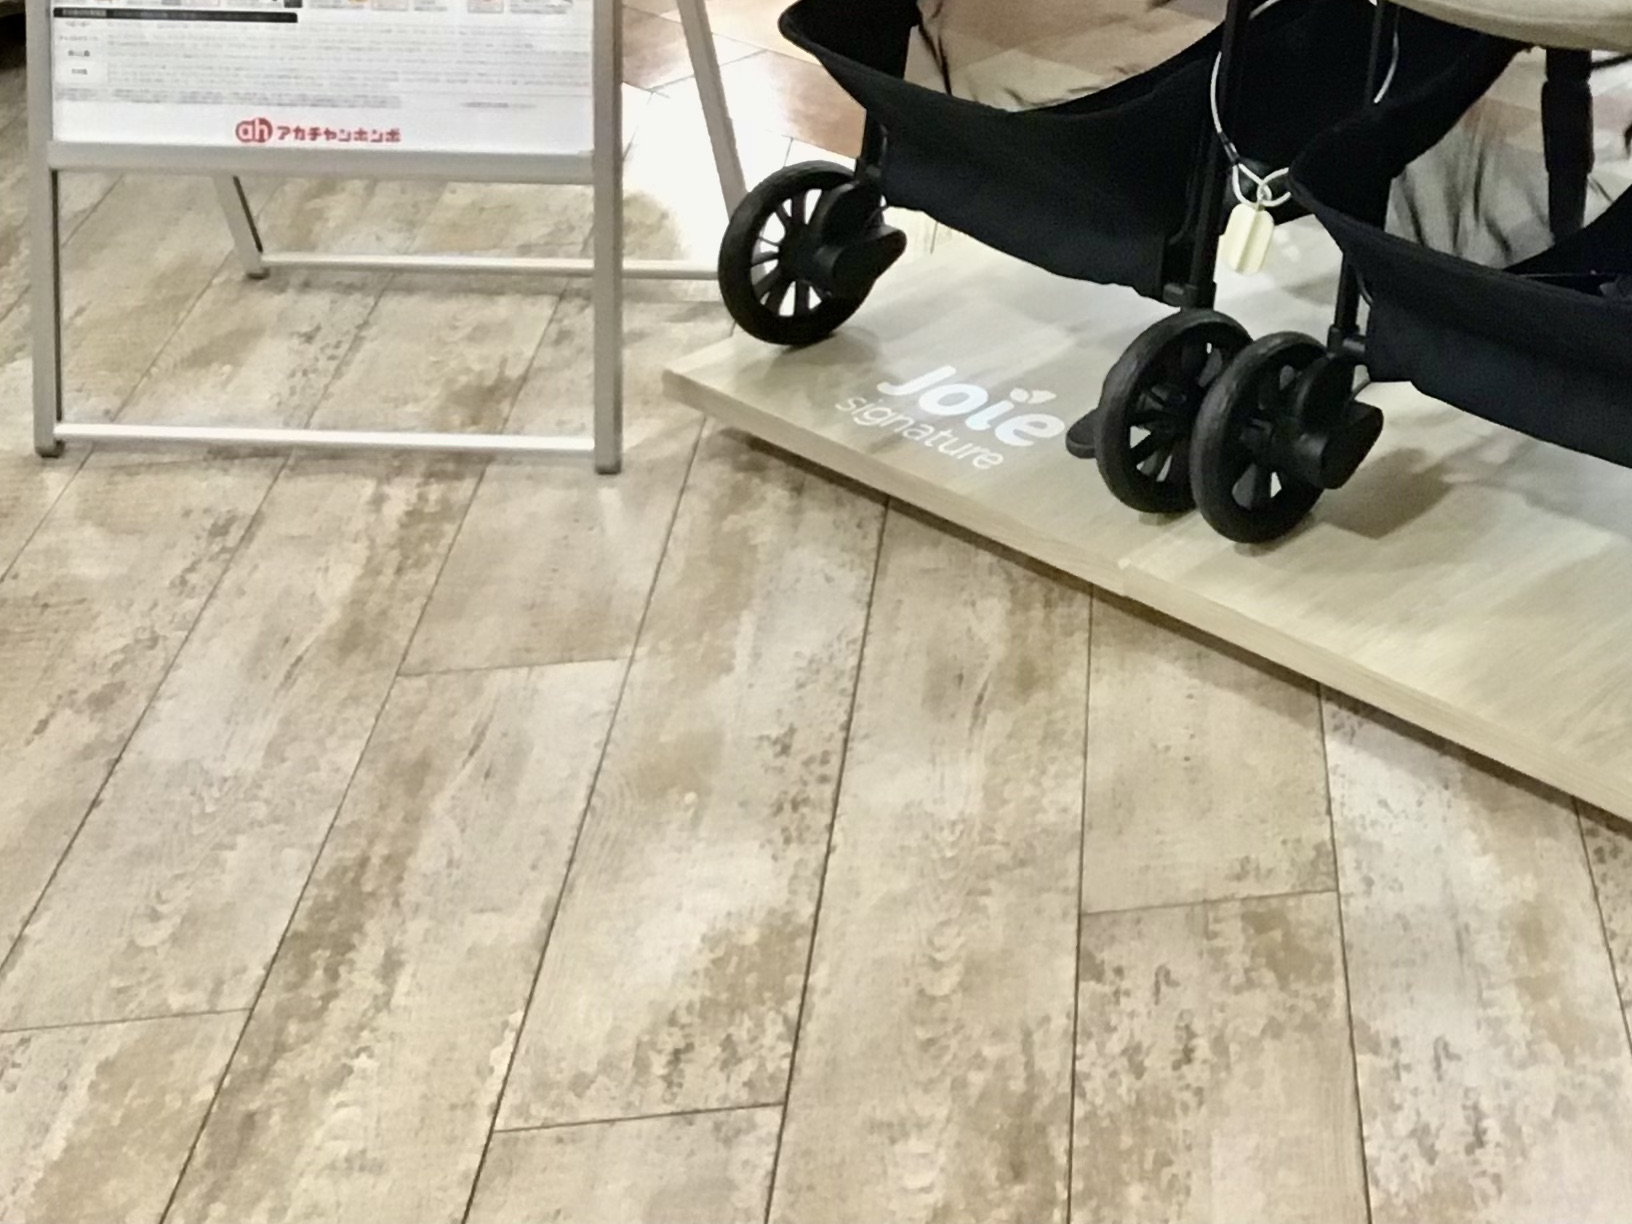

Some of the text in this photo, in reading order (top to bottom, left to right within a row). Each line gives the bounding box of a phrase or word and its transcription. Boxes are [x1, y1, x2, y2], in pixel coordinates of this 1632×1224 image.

[277, 125, 401, 144] アカチャンホンポ
[835, 396, 1004, 470] signature
[877, 365, 1066, 447] Joie
